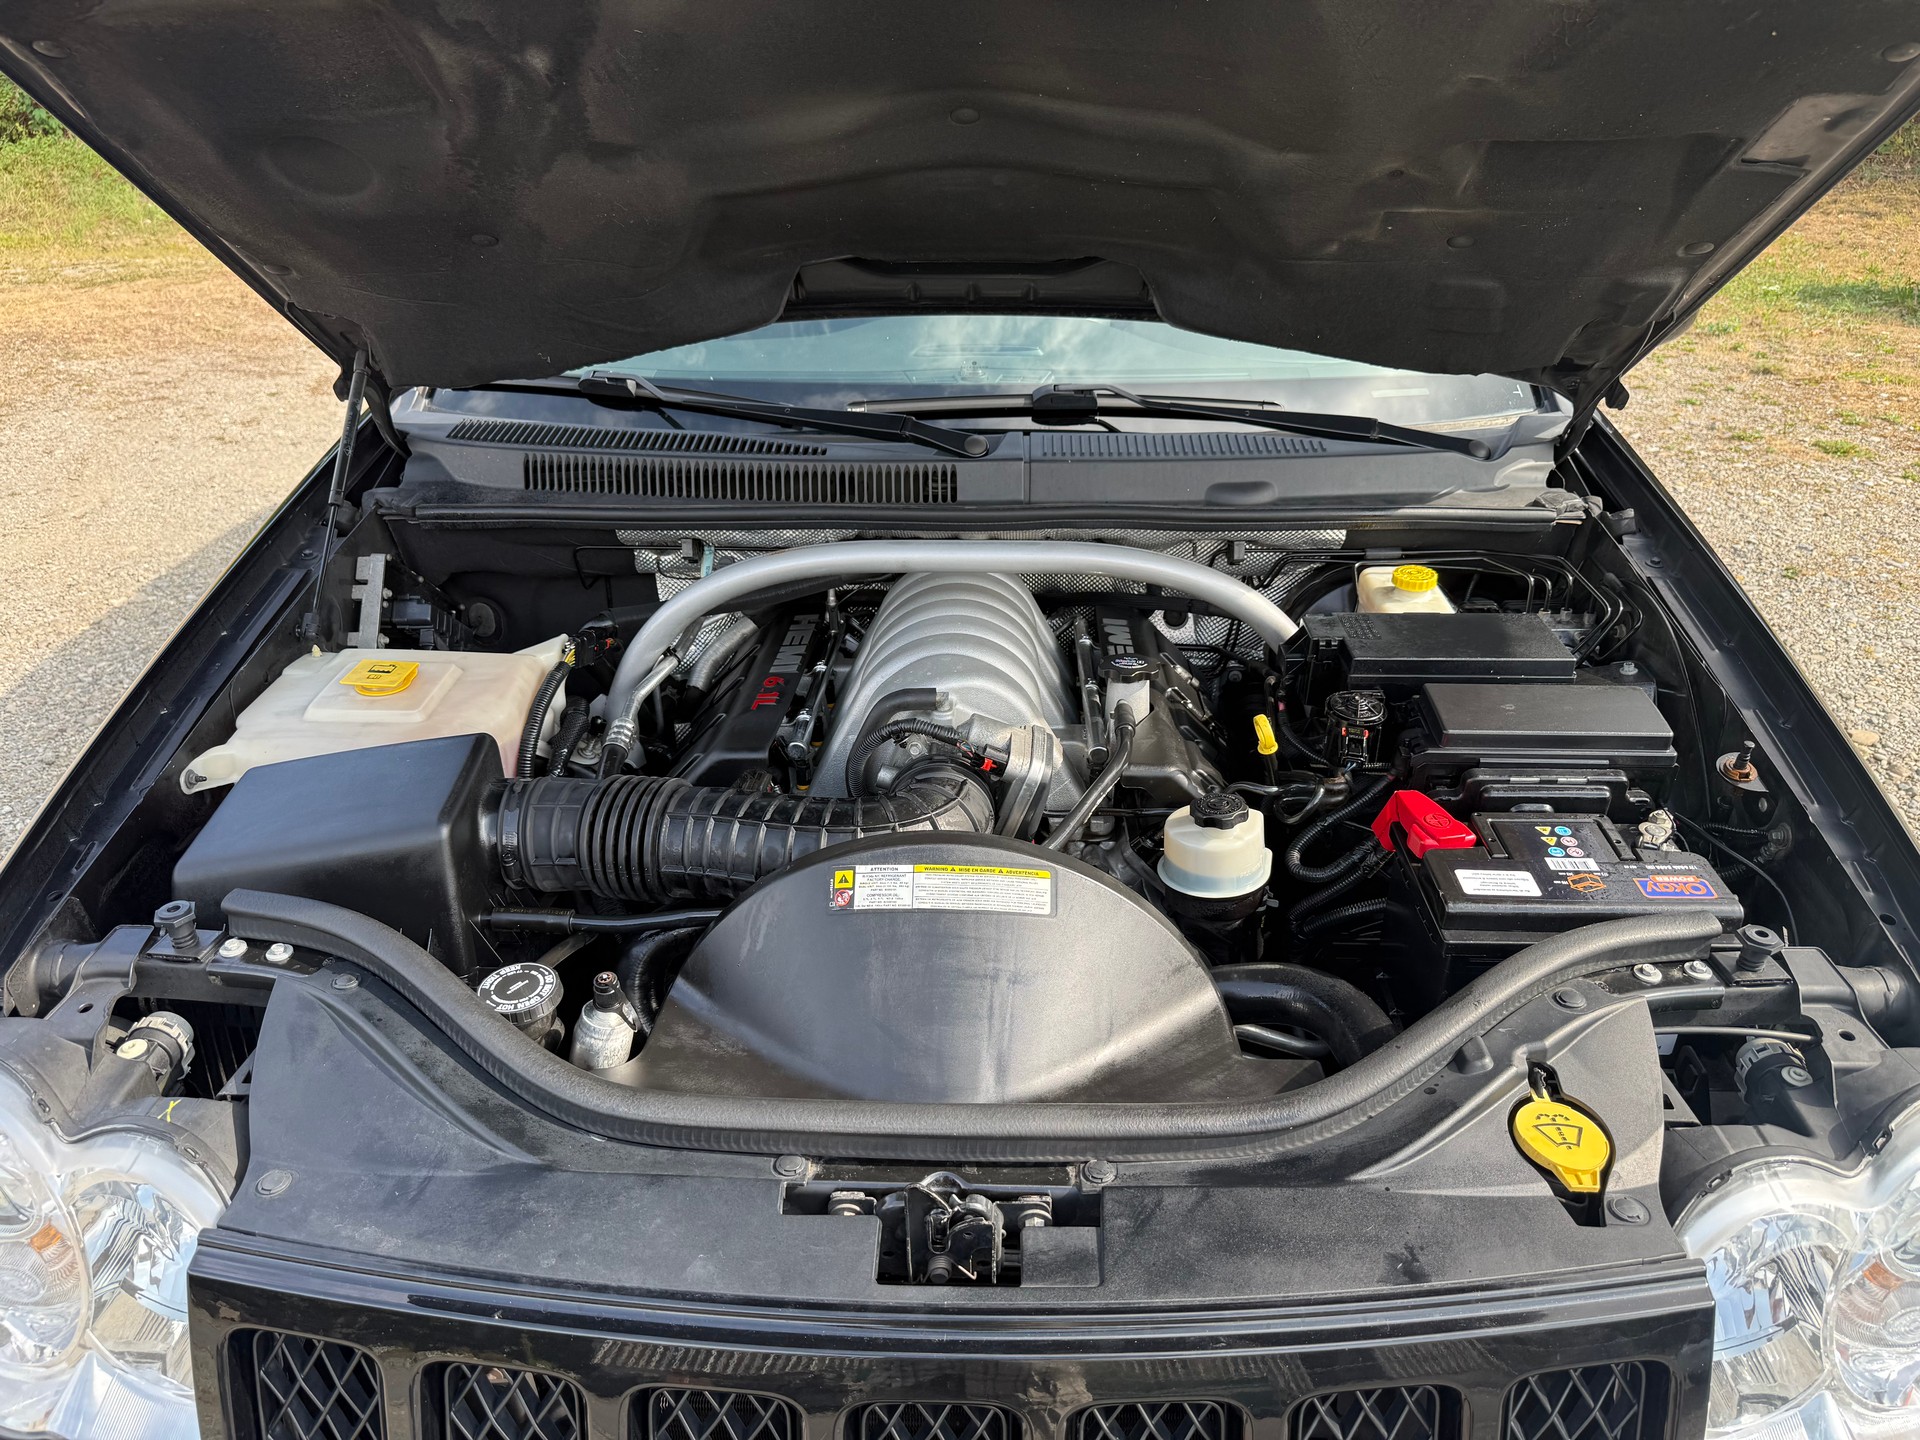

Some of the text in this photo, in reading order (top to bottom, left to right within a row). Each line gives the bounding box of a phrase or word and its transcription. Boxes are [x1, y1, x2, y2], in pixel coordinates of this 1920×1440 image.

[751, 614, 819, 711] HEMI 6.1L
[1646, 881, 1706, 895] Okay
[540, 983, 553, 996] NOT
[517, 995, 541, 1009] OPEN
